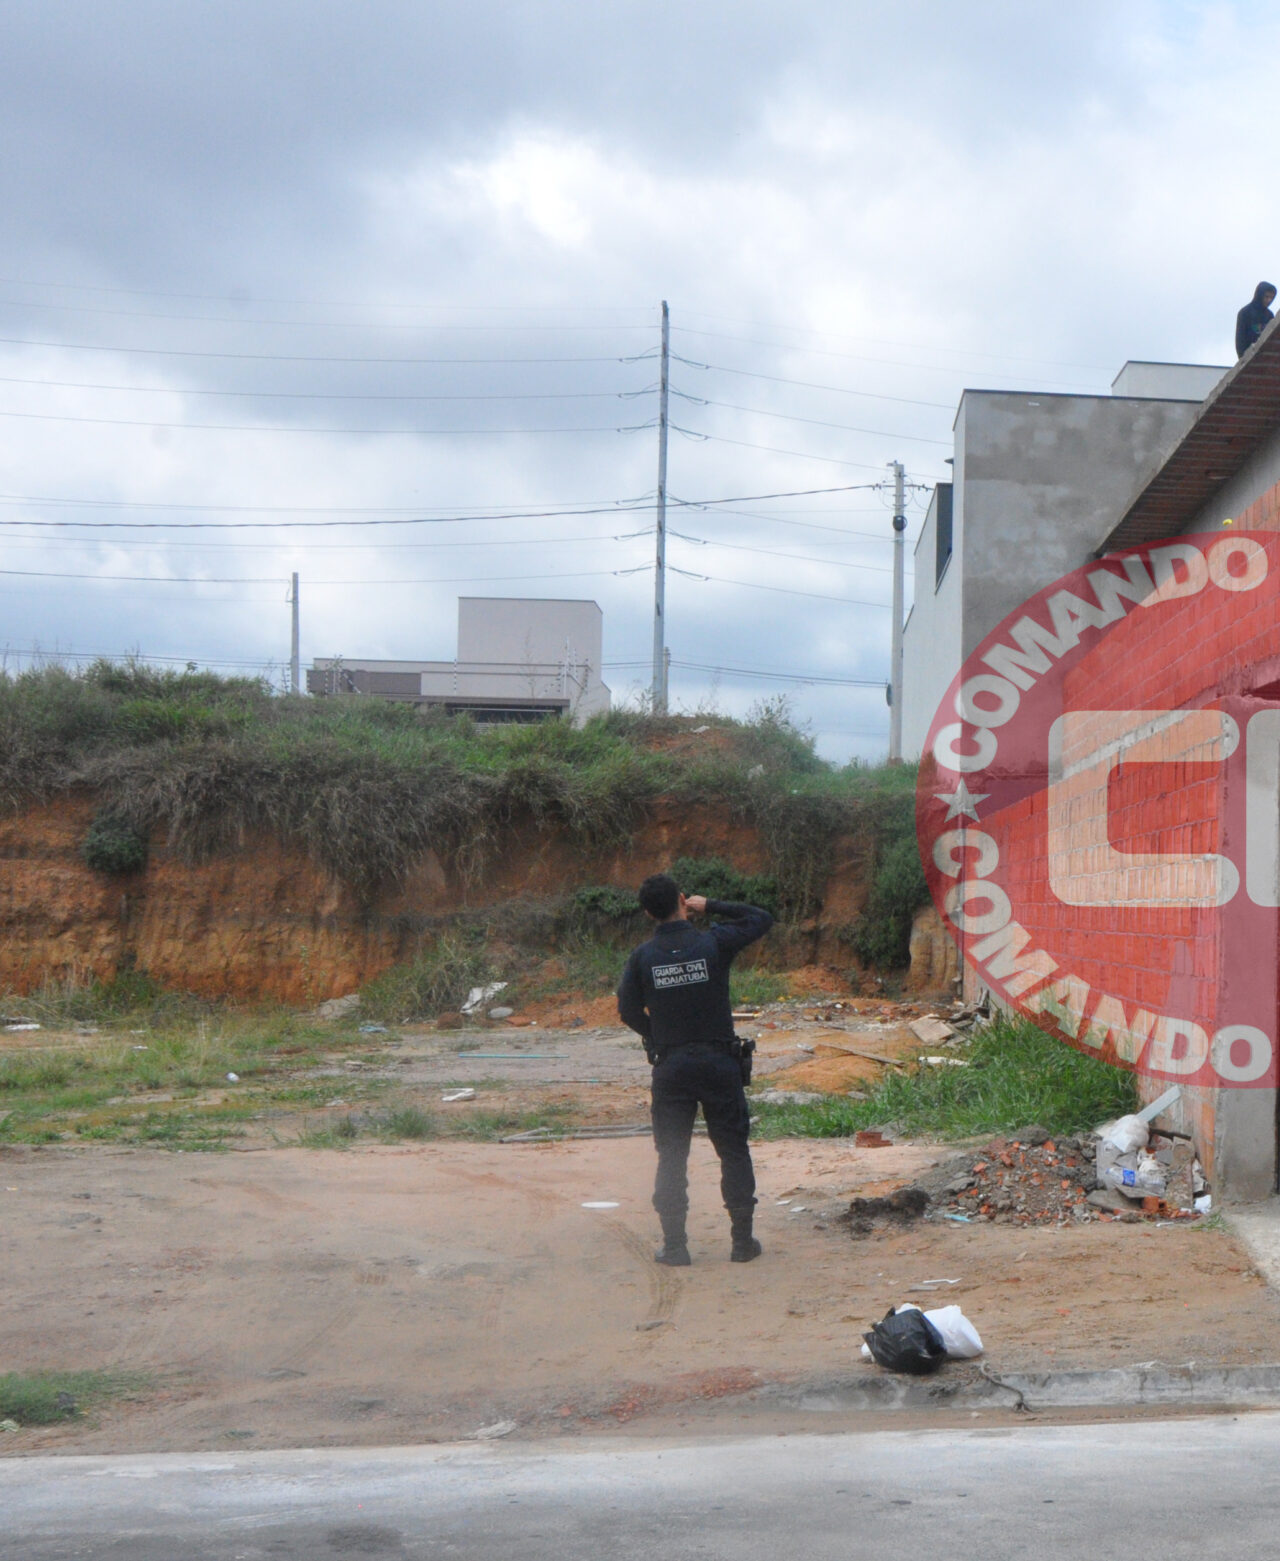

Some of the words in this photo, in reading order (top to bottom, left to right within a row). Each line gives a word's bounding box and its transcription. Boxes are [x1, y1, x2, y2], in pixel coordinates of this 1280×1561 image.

[655, 967, 684, 977] GUARDA
[686, 963, 705, 972] CIVIL
[656, 971, 706, 985] INDAIATUBA
